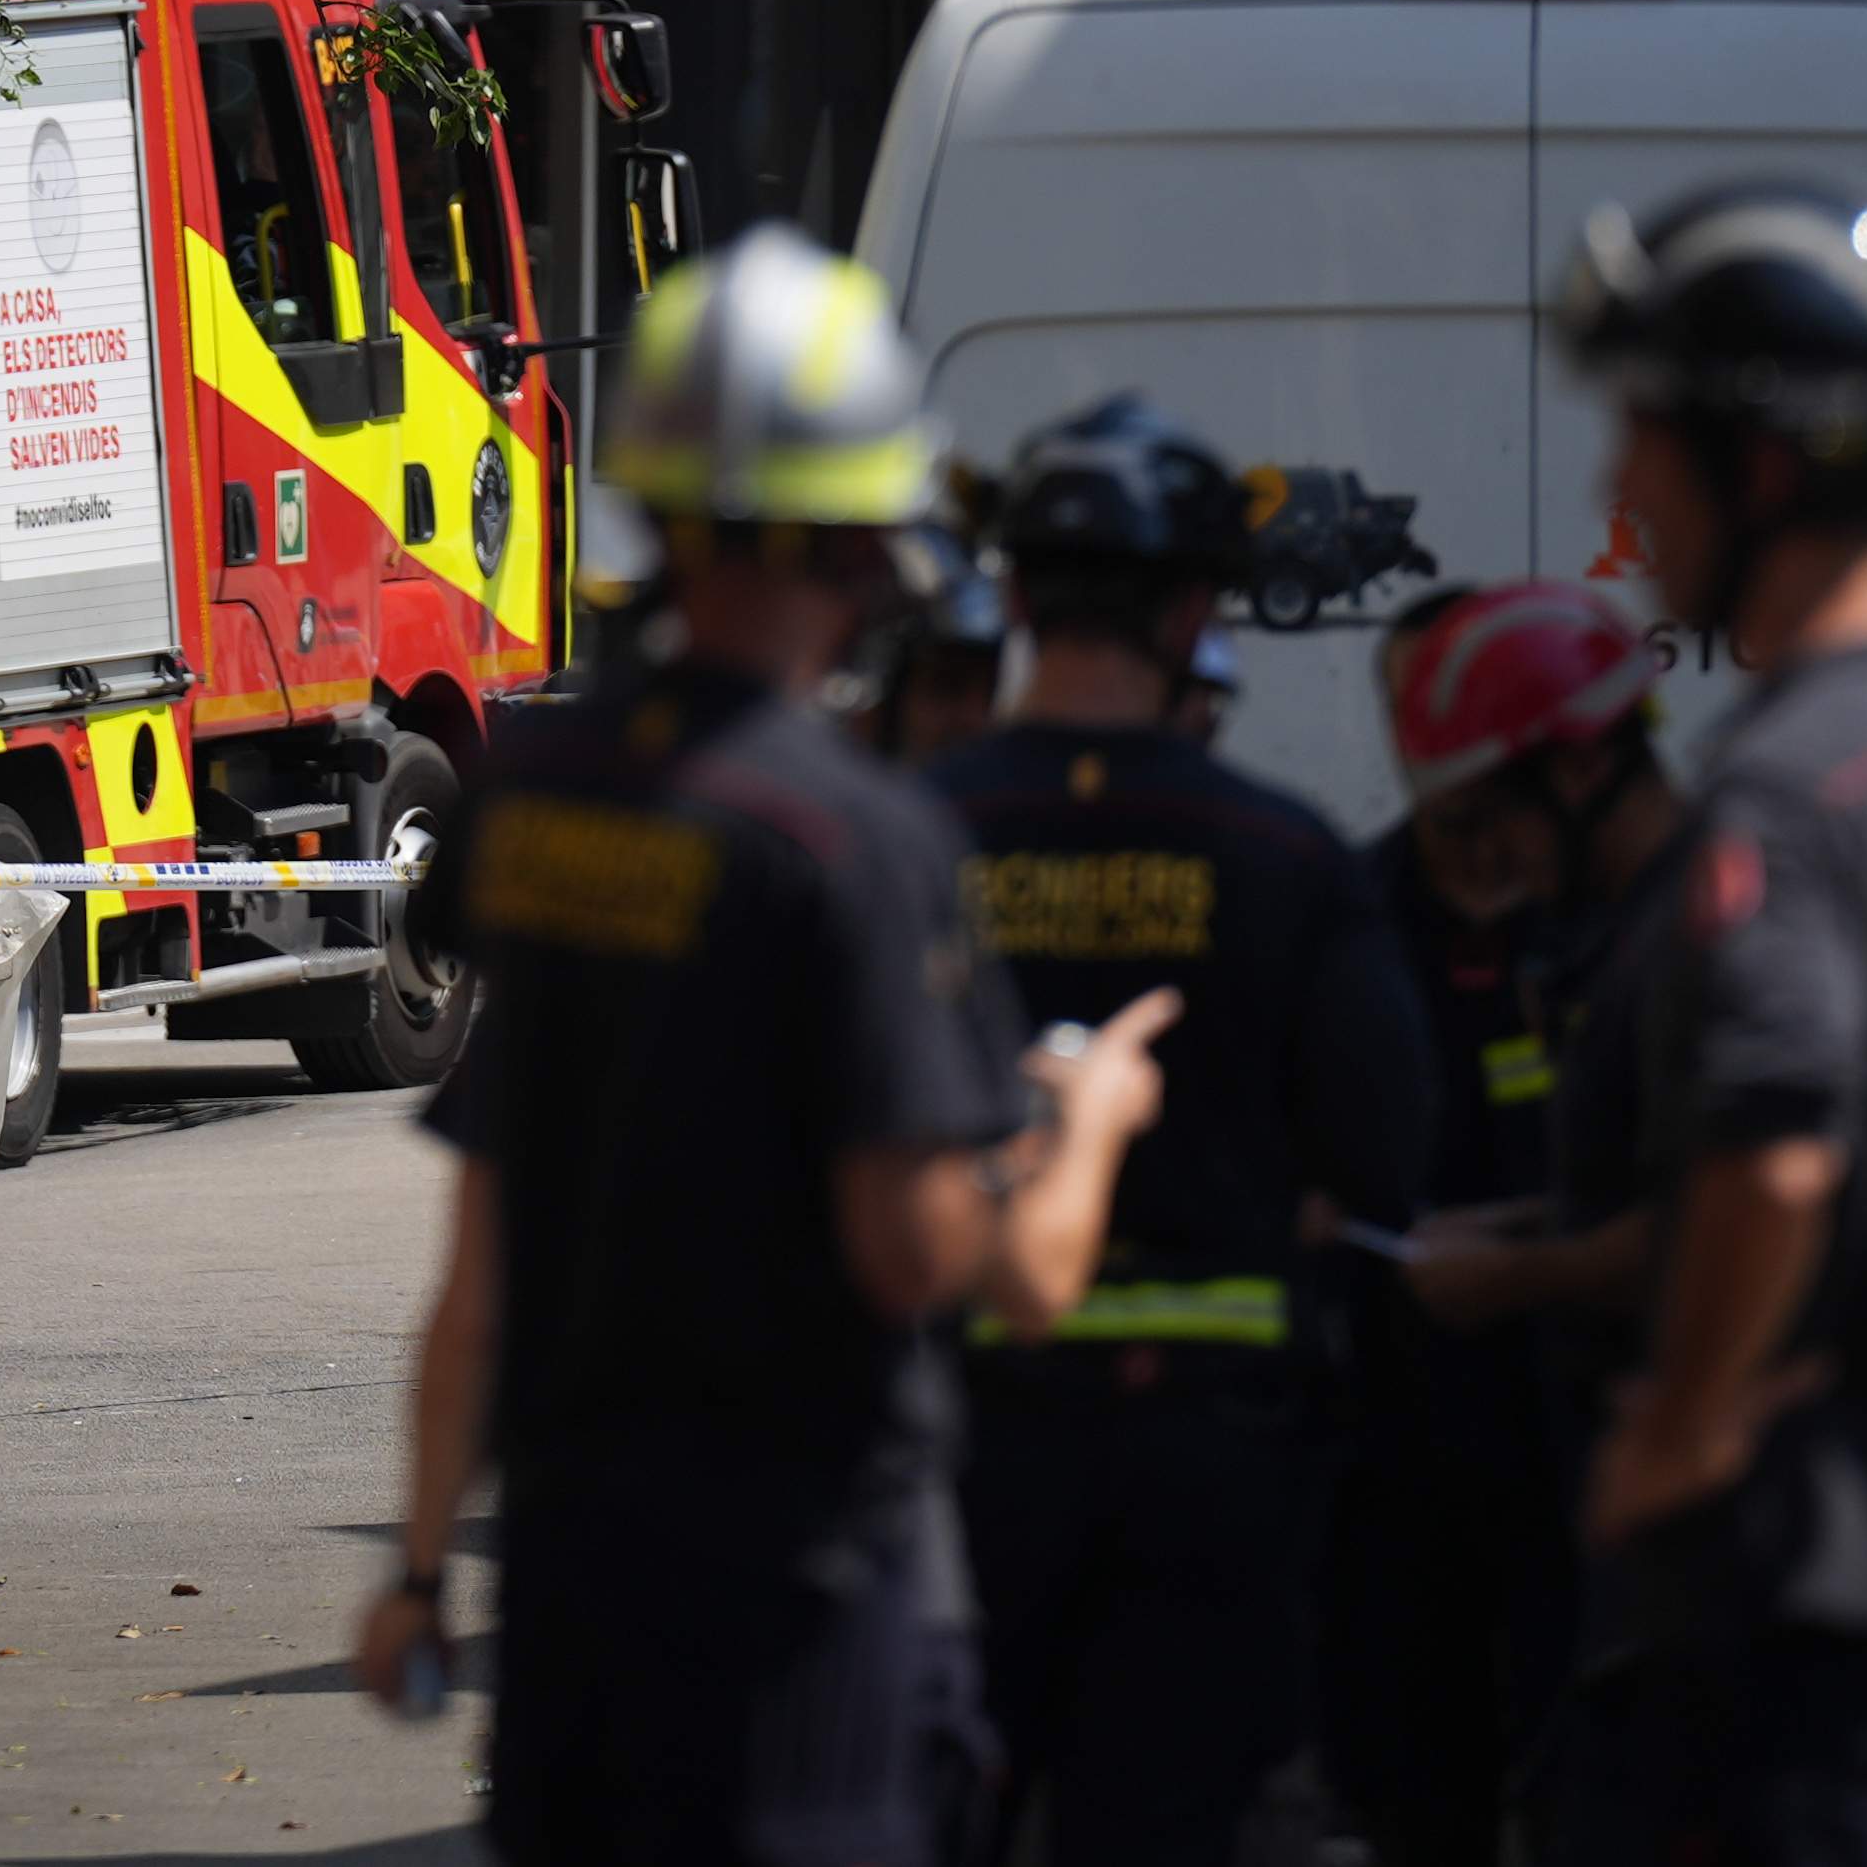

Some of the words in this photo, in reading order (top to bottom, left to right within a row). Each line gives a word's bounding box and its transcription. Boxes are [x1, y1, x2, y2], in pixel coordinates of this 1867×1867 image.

[0, 291, 11, 325] A
[14, 287, 61, 324] CASA,
[4, 338, 31, 373] ELS
[36, 328, 127, 370] DETECTORS
[6, 378, 97, 422] D'INCENDIS
[10, 431, 70, 470] SALVEN
[73, 425, 120, 462] VIDES
